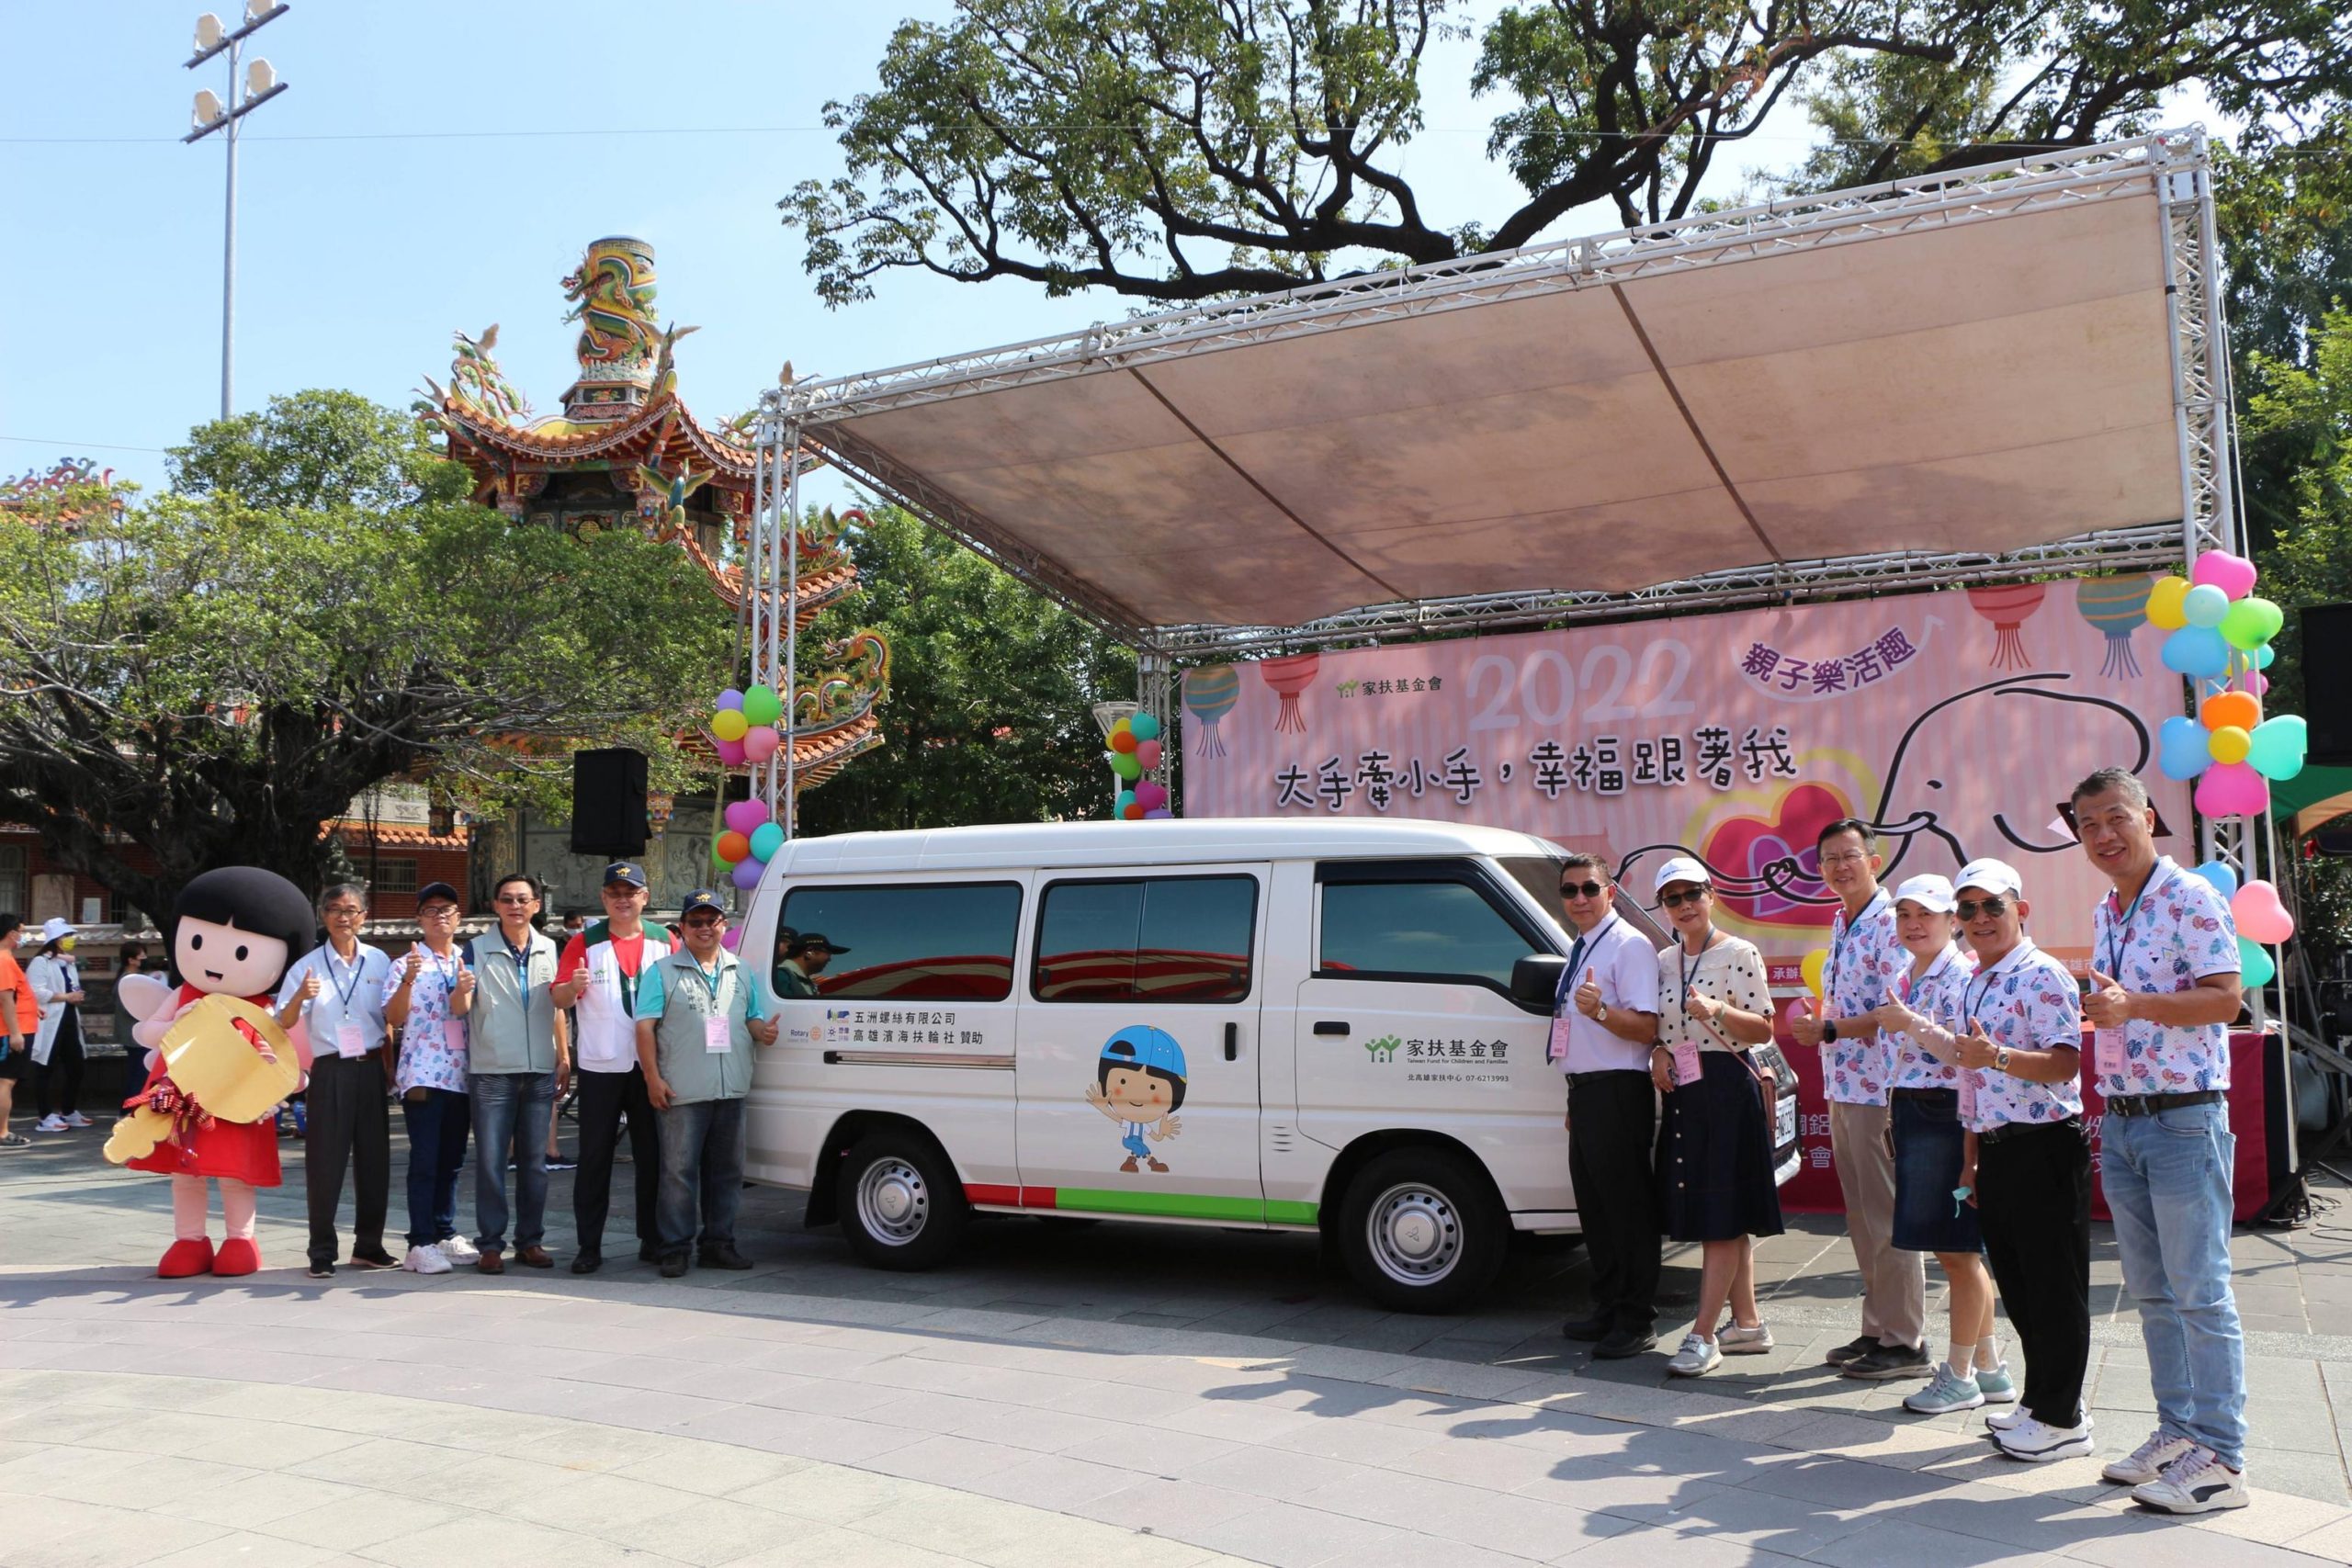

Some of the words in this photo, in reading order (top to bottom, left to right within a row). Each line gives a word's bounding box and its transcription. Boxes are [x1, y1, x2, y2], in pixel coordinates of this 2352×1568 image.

[1742, 626, 1917, 694] 親子樂活趣
[1362, 675, 1442, 696] 家扶基金會
[1467, 638, 1696, 731] 2022
[1772, 966, 1802, 980] 承辦
[854, 1011, 956, 1026] 五洲螺絲有限公司
[790, 1029, 809, 1038] Rotary
[854, 1029, 955, 1044] 高雄濱海扶輪社
[1407, 1039, 1509, 1057] 家扶基金會
[1407, 1074, 1463, 1082] 北高雄家扶中心
[1802, 1146, 1832, 1168] 會
